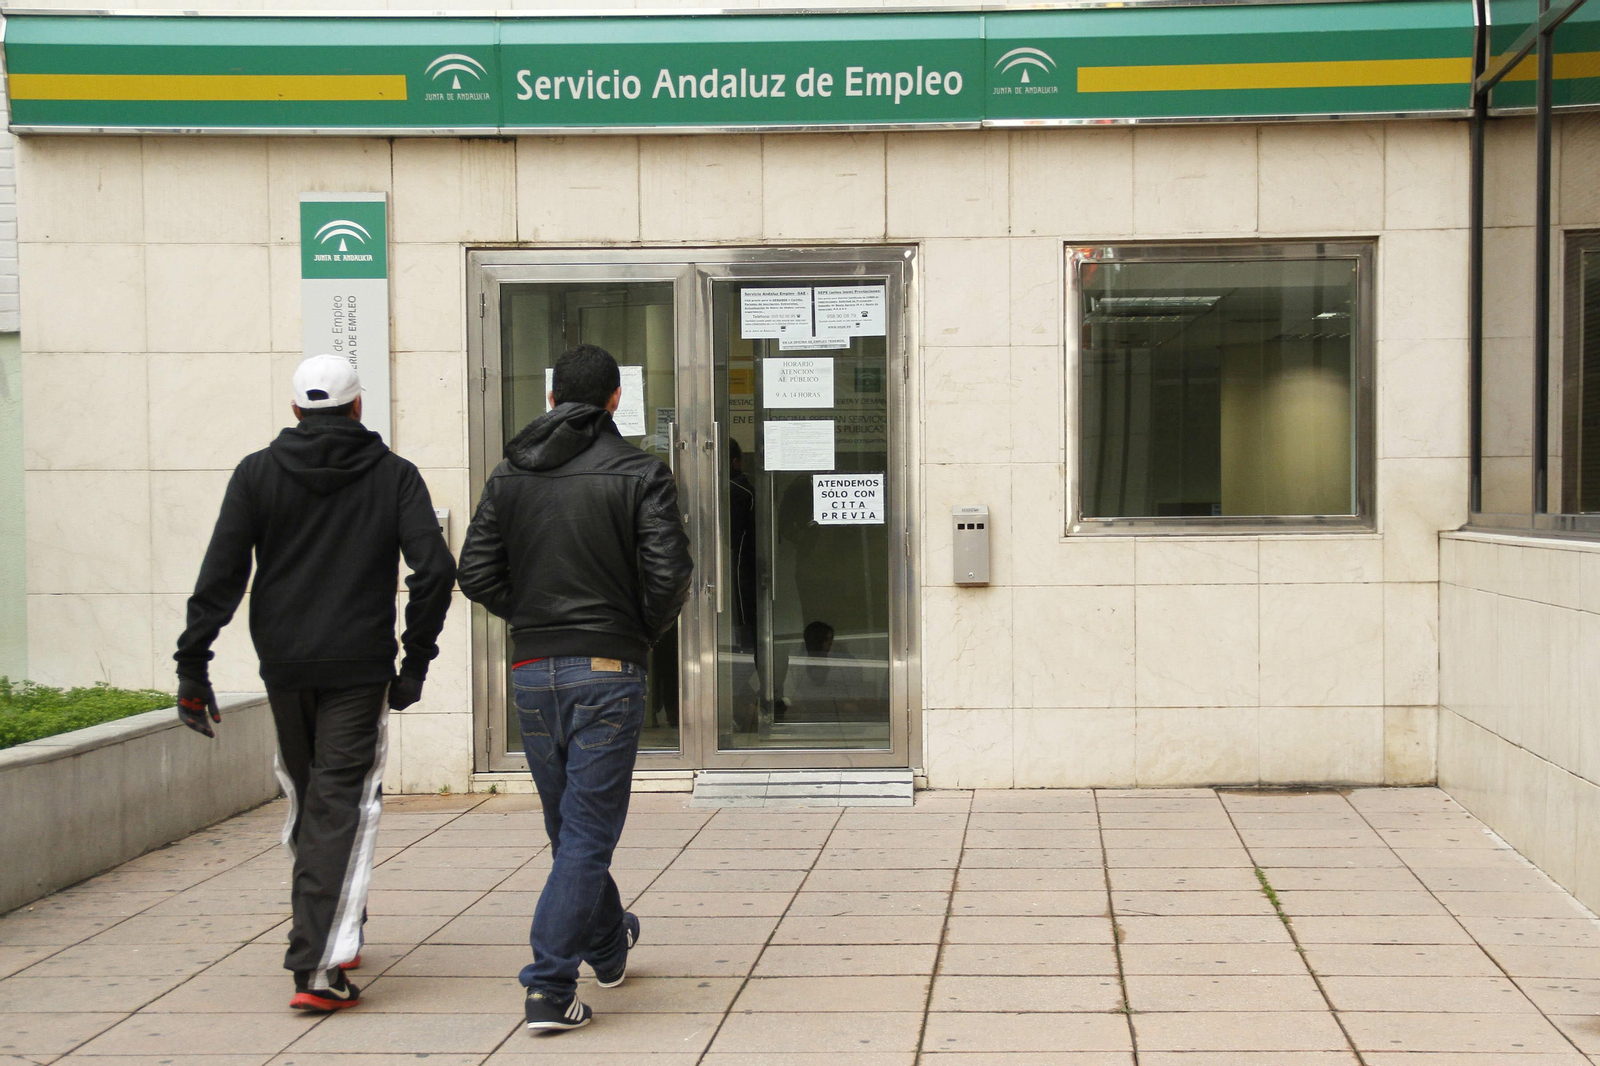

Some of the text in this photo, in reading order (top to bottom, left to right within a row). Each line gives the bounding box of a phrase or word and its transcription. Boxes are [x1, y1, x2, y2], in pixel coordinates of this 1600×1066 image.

[516, 65, 963, 105] Servicio Andaluz de Empleo
[993, 87, 1012, 95] JUNTA
[425, 93, 444, 101] JUNTA
[446, 93, 454, 101] DE
[313, 254, 332, 262] JUNTA
[333, 254, 341, 262] DE
[348, 295, 357, 332] EMPLEO
[332, 295, 345, 352] de Empleo
[348, 335, 357, 347] DE
[789, 375, 819, 383] PÚBLICO
[733, 415, 745, 424] EN
[817, 479, 879, 488] ATENDEMOS
[821, 488, 875, 499] SÓLO CON
[831, 501, 866, 509] CITA
[821, 511, 876, 519] PREVIA
